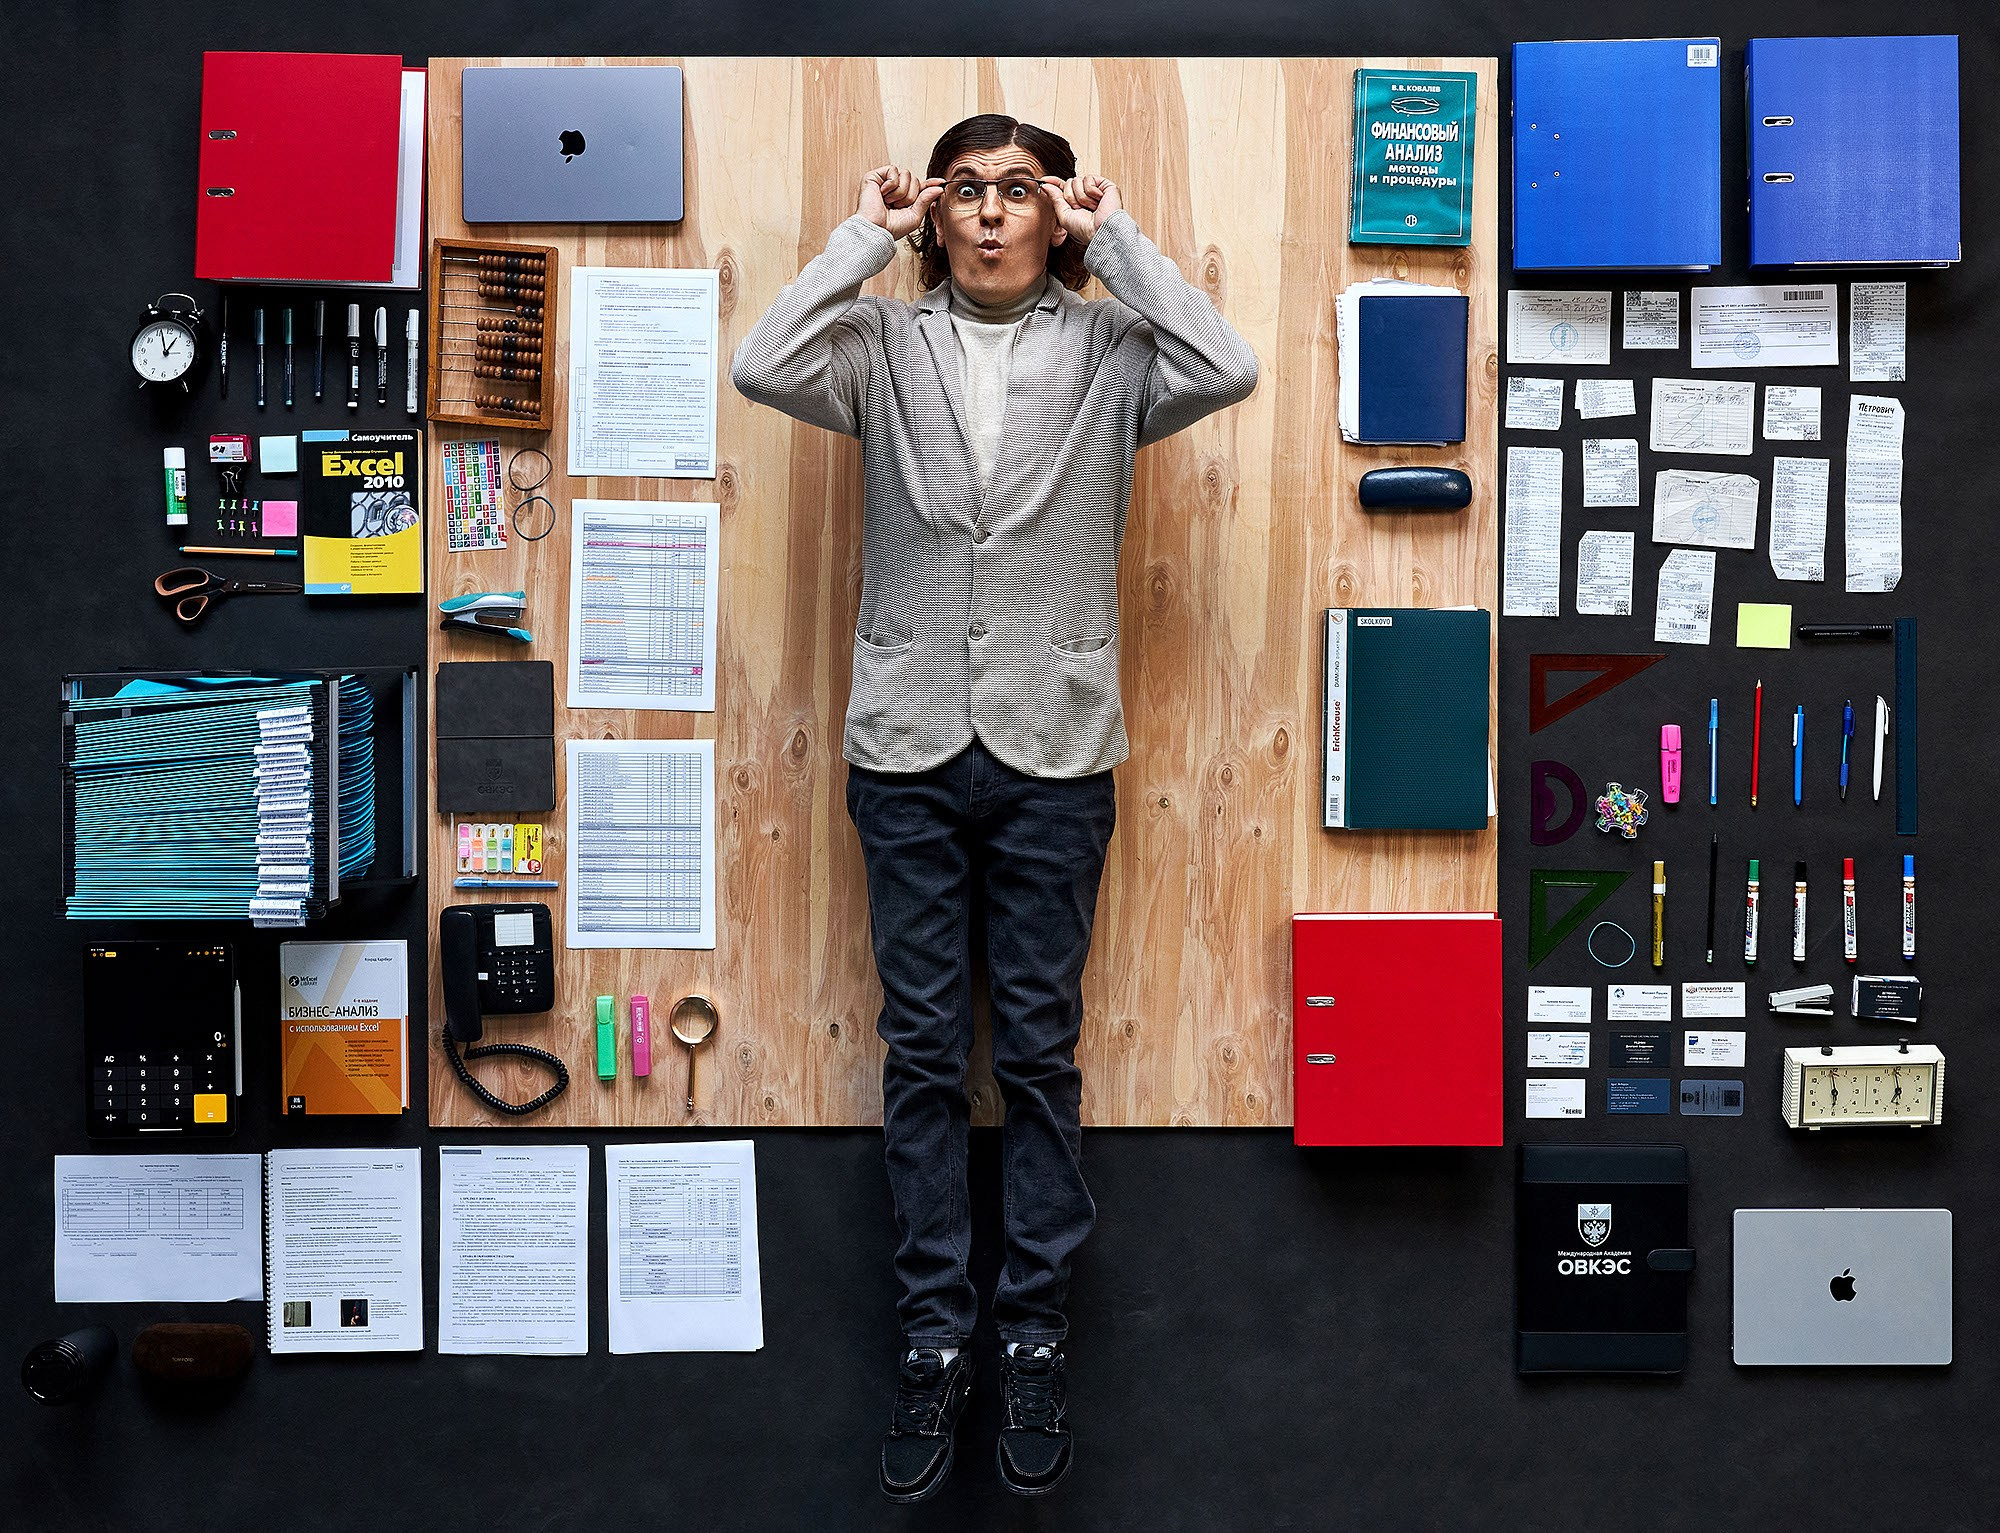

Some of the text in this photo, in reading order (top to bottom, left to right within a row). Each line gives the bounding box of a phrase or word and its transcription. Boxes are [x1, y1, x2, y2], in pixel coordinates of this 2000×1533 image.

[1371, 121, 1459, 142] ФИНАНСОВЫЙ
[1385, 144, 1443, 162] АНАЛИЗ
[1388, 164, 1438, 175] методы
[1370, 175, 1456, 188] и процедуры
[352, 434, 413, 442] Самоучитель
[322, 452, 403, 476] Excel
[364, 476, 404, 488] 2010
[1332, 701, 1341, 752] ErichKrause
[289, 1006, 379, 1018] БИЗНЕС-АНАЛИЗ
[296, 1024, 358, 1032] использованием
[360, 1023, 379, 1031] Excel
[214, 1031, 222, 1041] 0
[1558, 1259, 1631, 1275] ОВКЭС
